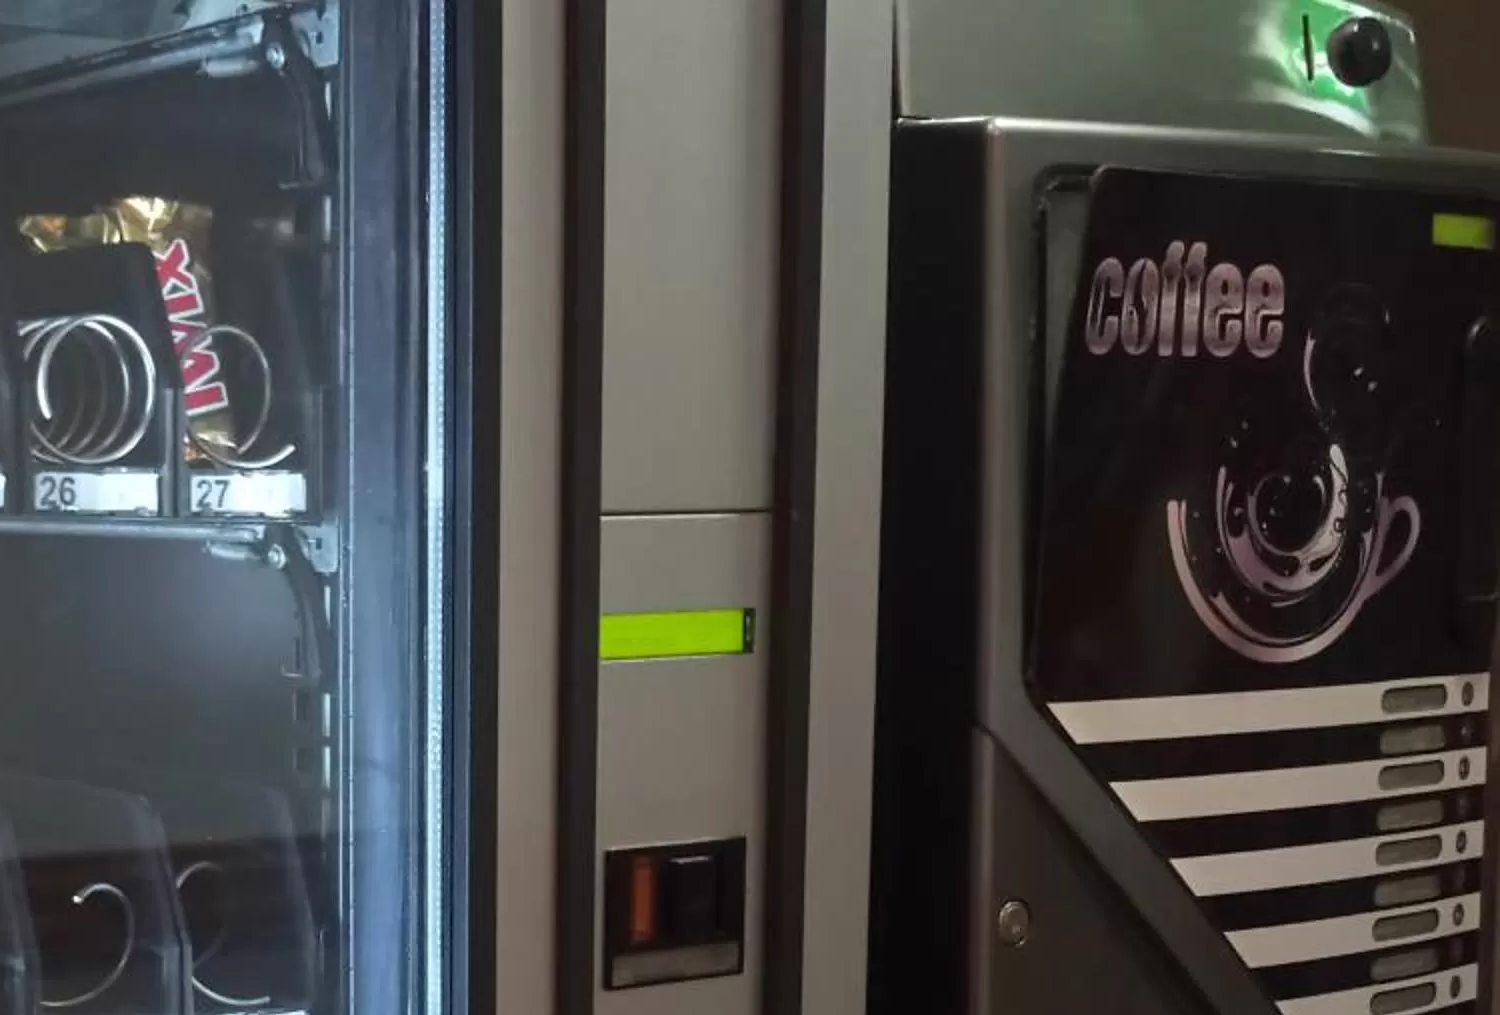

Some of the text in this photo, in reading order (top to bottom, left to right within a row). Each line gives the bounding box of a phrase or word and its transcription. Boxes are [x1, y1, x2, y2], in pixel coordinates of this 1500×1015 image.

[1085, 240, 1286, 359] coffee
[39, 476, 76, 509] 26
[196, 480, 230, 509] 27
